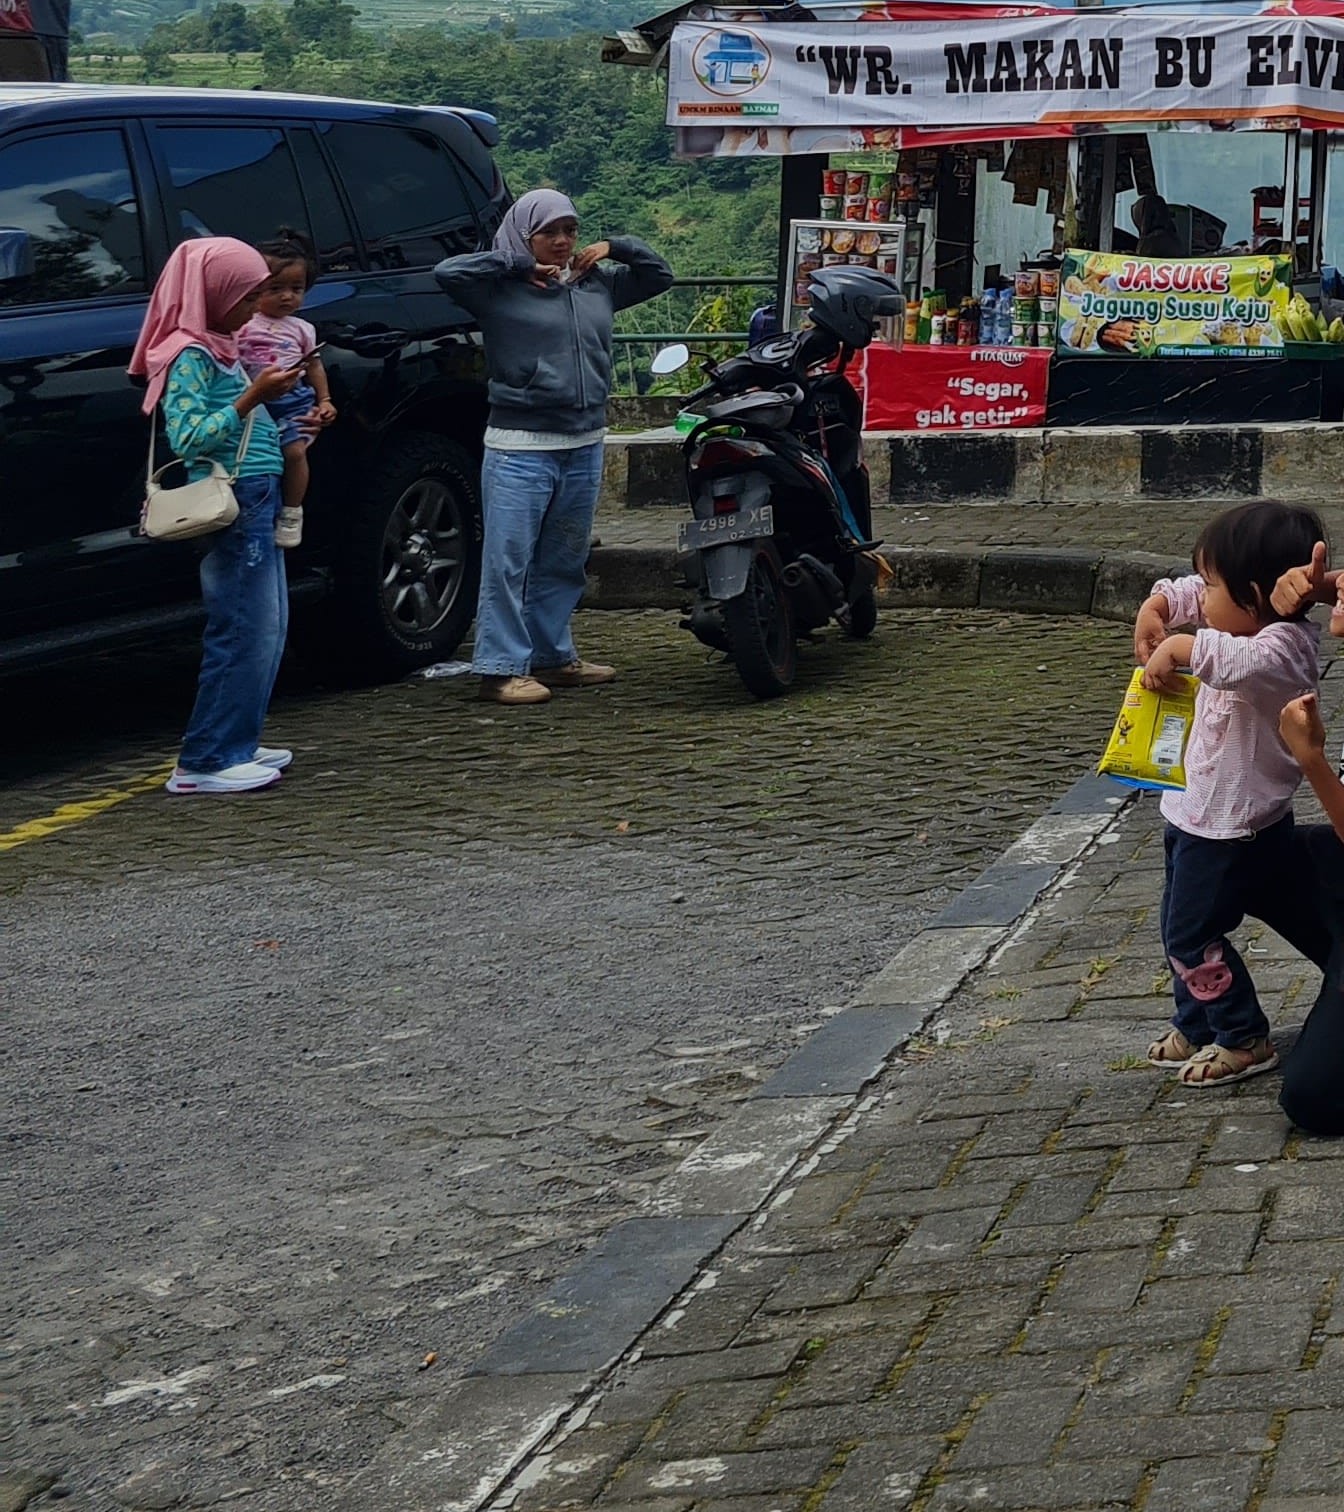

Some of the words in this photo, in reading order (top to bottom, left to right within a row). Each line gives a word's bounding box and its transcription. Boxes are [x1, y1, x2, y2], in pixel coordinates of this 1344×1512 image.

[943, 36, 1124, 94] MAKAN
[1154, 35, 1216, 90] BU
[1118, 262, 1231, 292] JASUKE
[1081, 293, 1160, 322] Jagung
[1164, 296, 1216, 321] Susu
[1222, 298, 1269, 327] Keju
[915, 403, 957, 428] gak
[679, 522, 687, 536] H
[700, 515, 737, 532] 4998
[749, 507, 770, 524] XE
